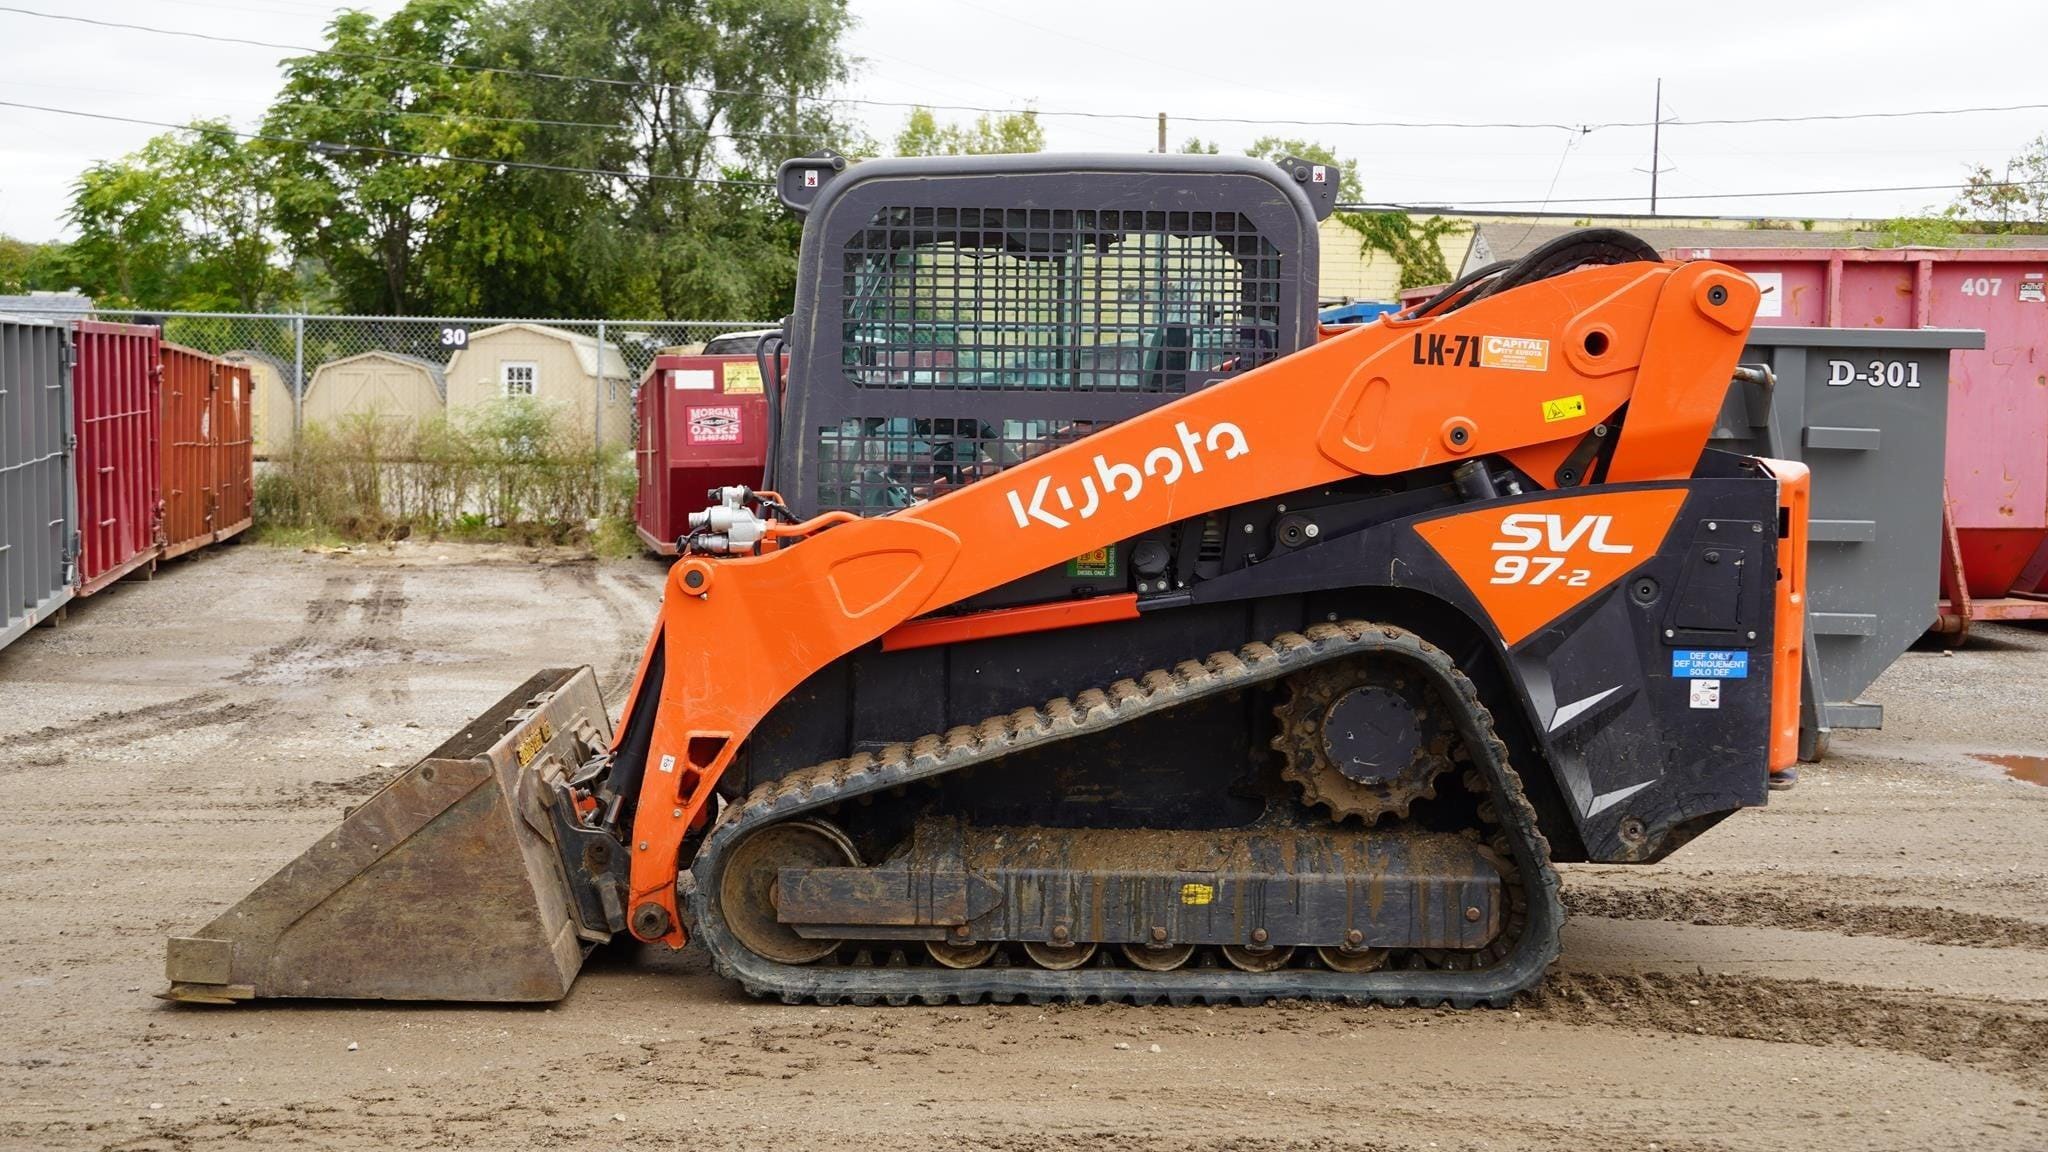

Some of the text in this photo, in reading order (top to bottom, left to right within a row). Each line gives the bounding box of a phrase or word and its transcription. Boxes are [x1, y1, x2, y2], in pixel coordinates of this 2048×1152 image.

[1961, 278, 2002, 296] 407
[441, 328, 466, 346] 30
[1488, 338, 1543, 354] CAPITAL
[1413, 333, 1480, 367] LK-71
[1828, 360, 1920, 388] D-301
[690, 407, 739, 422] MORGAN
[690, 425, 740, 436] OAKS
[1006, 421, 1250, 529] Kubota
[1491, 513, 1634, 554] SVL
[1490, 556, 1591, 587] 97-2
[1674, 660, 1746, 669] DEF UNIQUEMENT
[1690, 652, 1730, 660] DEF ONLY
[1690, 668, 1730, 676] SOLO DEF
